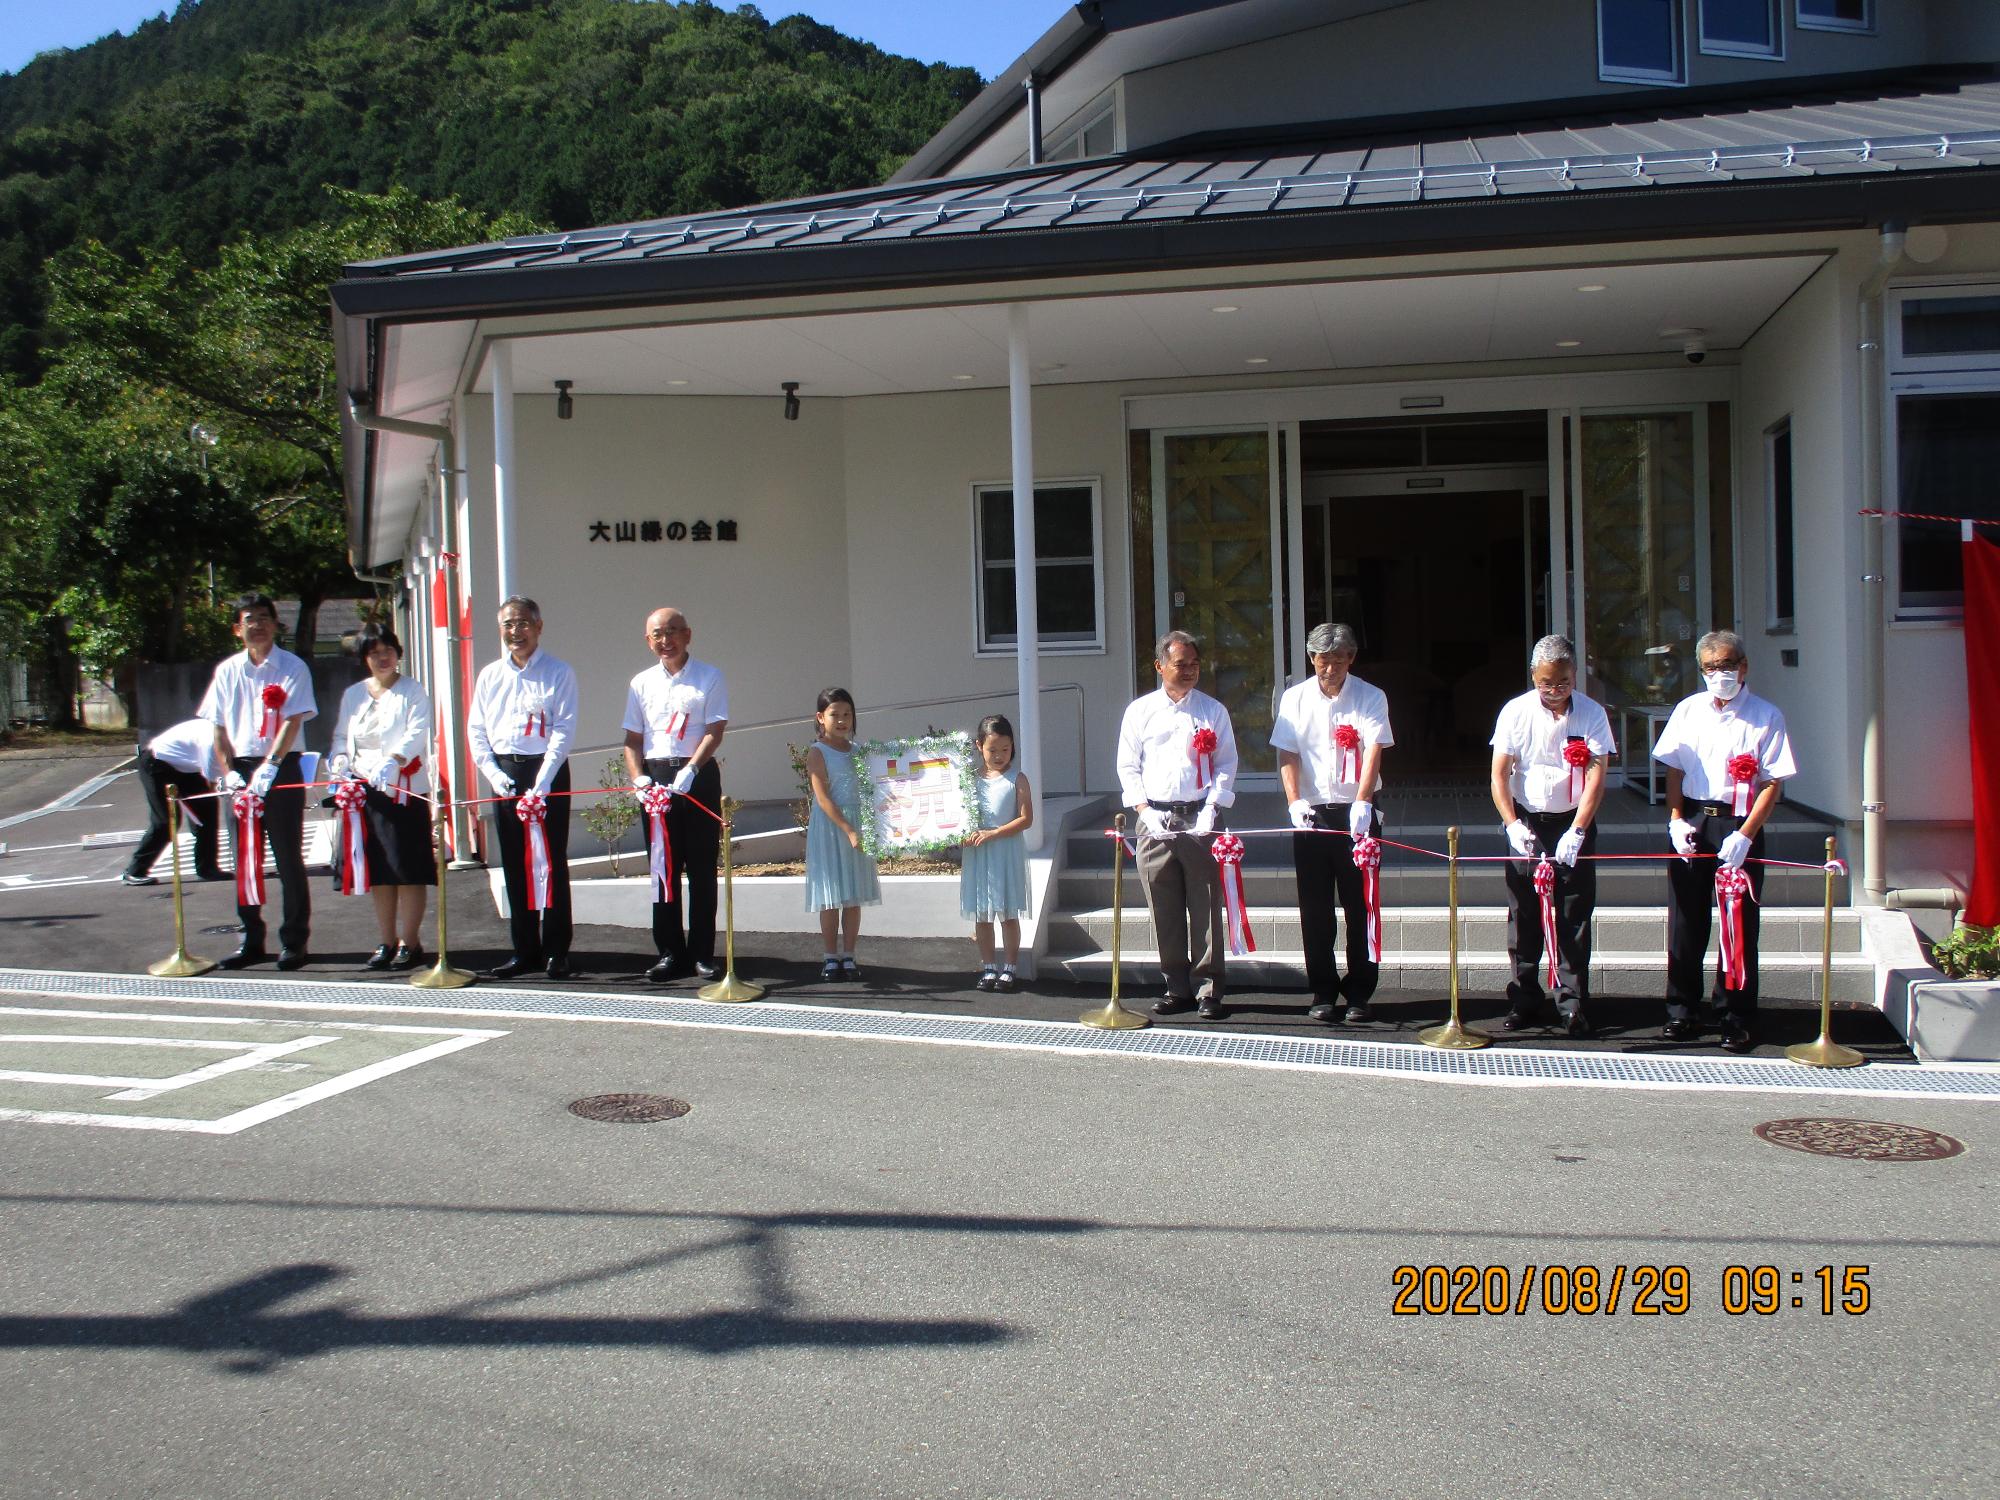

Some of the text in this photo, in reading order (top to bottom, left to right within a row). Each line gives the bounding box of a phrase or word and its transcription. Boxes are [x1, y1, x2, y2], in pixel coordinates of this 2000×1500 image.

[589, 519, 738, 542] 大山緑の会館
[875, 757, 960, 838] 祝
